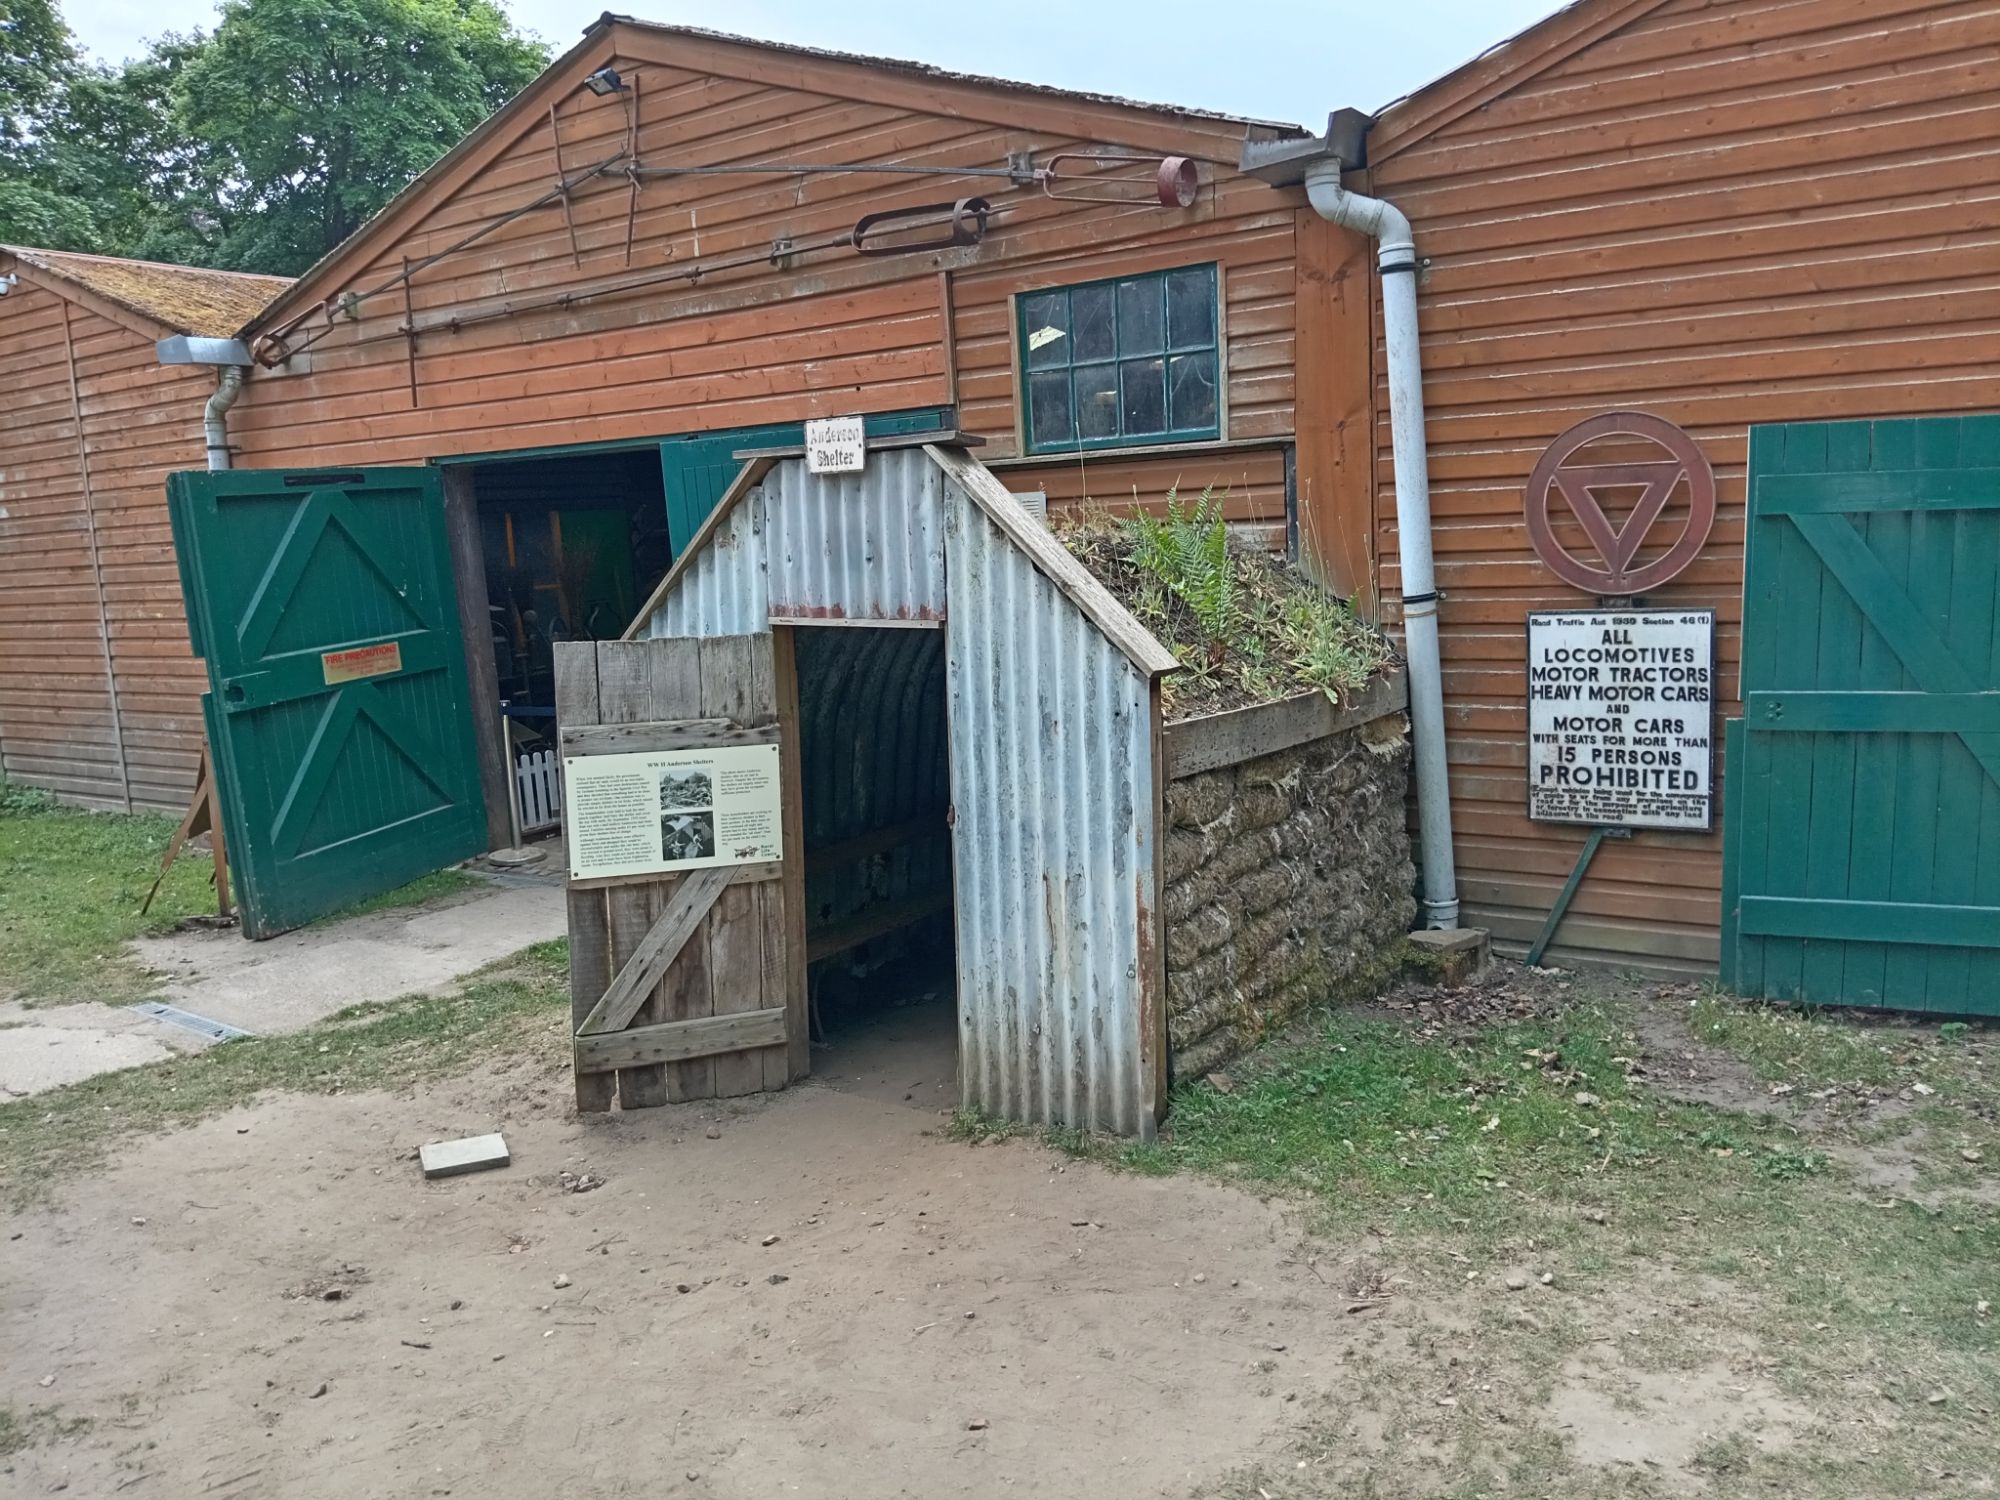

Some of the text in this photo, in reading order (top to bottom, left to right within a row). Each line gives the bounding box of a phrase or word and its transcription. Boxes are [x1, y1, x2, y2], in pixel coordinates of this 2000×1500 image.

[810, 426, 860, 445] Anderson
[817, 448, 855, 467] Shelter
[1531, 618, 1551, 626] Road
[1556, 618, 1585, 626] Traffic
[1642, 617, 1674, 625] Section
[1602, 629, 1633, 645] ALL
[325, 655, 343, 664] FIRE
[1544, 647, 1695, 664] LOCOMOTIVES
[1531, 666, 1708, 683] MOTOR TRACTORS
[1531, 684, 1709, 702] HEAVY MOTOR CARS
[1606, 704, 1630, 714] AND
[1553, 717, 1685, 734] MOTOR CARS
[1532, 733, 1708, 748] WITH SEATS FOR MORE THAN
[1557, 746, 1682, 766] 15 PERSONS
[1540, 765, 1699, 789] PROHIBITED
[1602, 802, 1638, 810] purposes
[1656, 804, 1703, 813] agriculture
[1637, 797, 1673, 805] premises
[1547, 804, 1579, 813] forestry
[1593, 807, 1638, 815] connection
[1665, 811, 1681, 819] any
[1684, 811, 1702, 819] land
